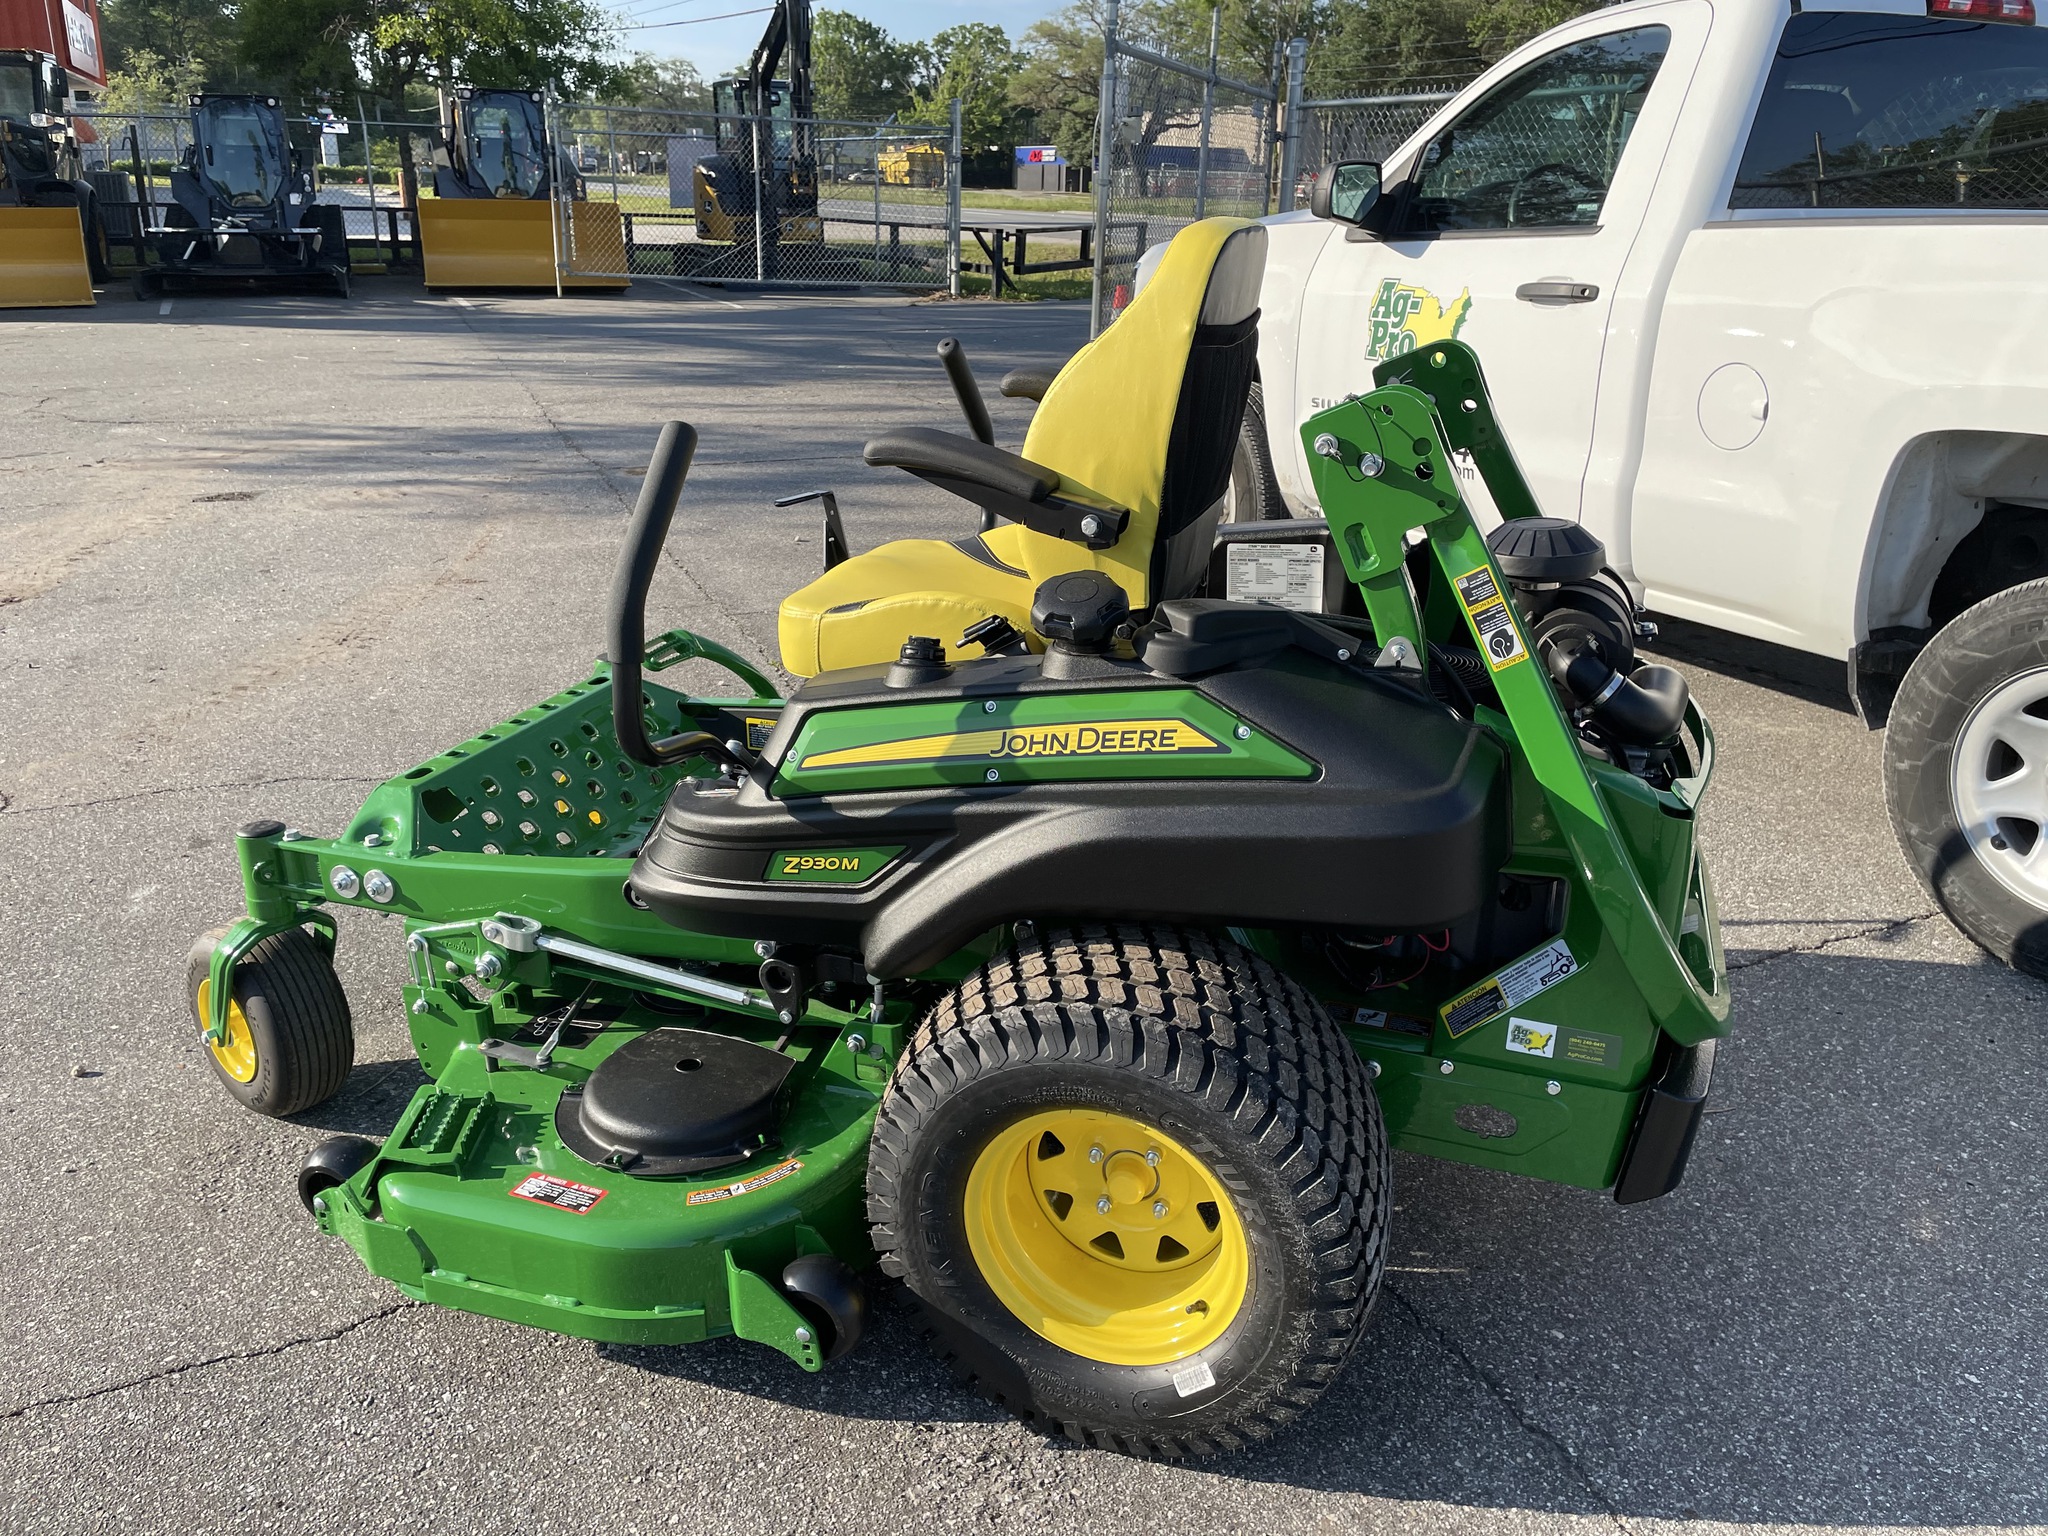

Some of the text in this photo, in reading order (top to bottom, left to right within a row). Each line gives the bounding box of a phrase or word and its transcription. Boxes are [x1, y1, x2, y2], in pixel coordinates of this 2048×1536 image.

[1371, 280, 1421, 328] Ag-
[1366, 320, 1416, 359] Pro
[1495, 655, 1522, 670] CAUTION
[988, 727, 1178, 756] JOHN DEERE
[782, 855, 860, 875] Z930M
[1457, 985, 1488, 1007] ATENCIÓN
[1510, 1034, 1531, 1045] Pro
[917, 1143, 961, 1288] KENDA
